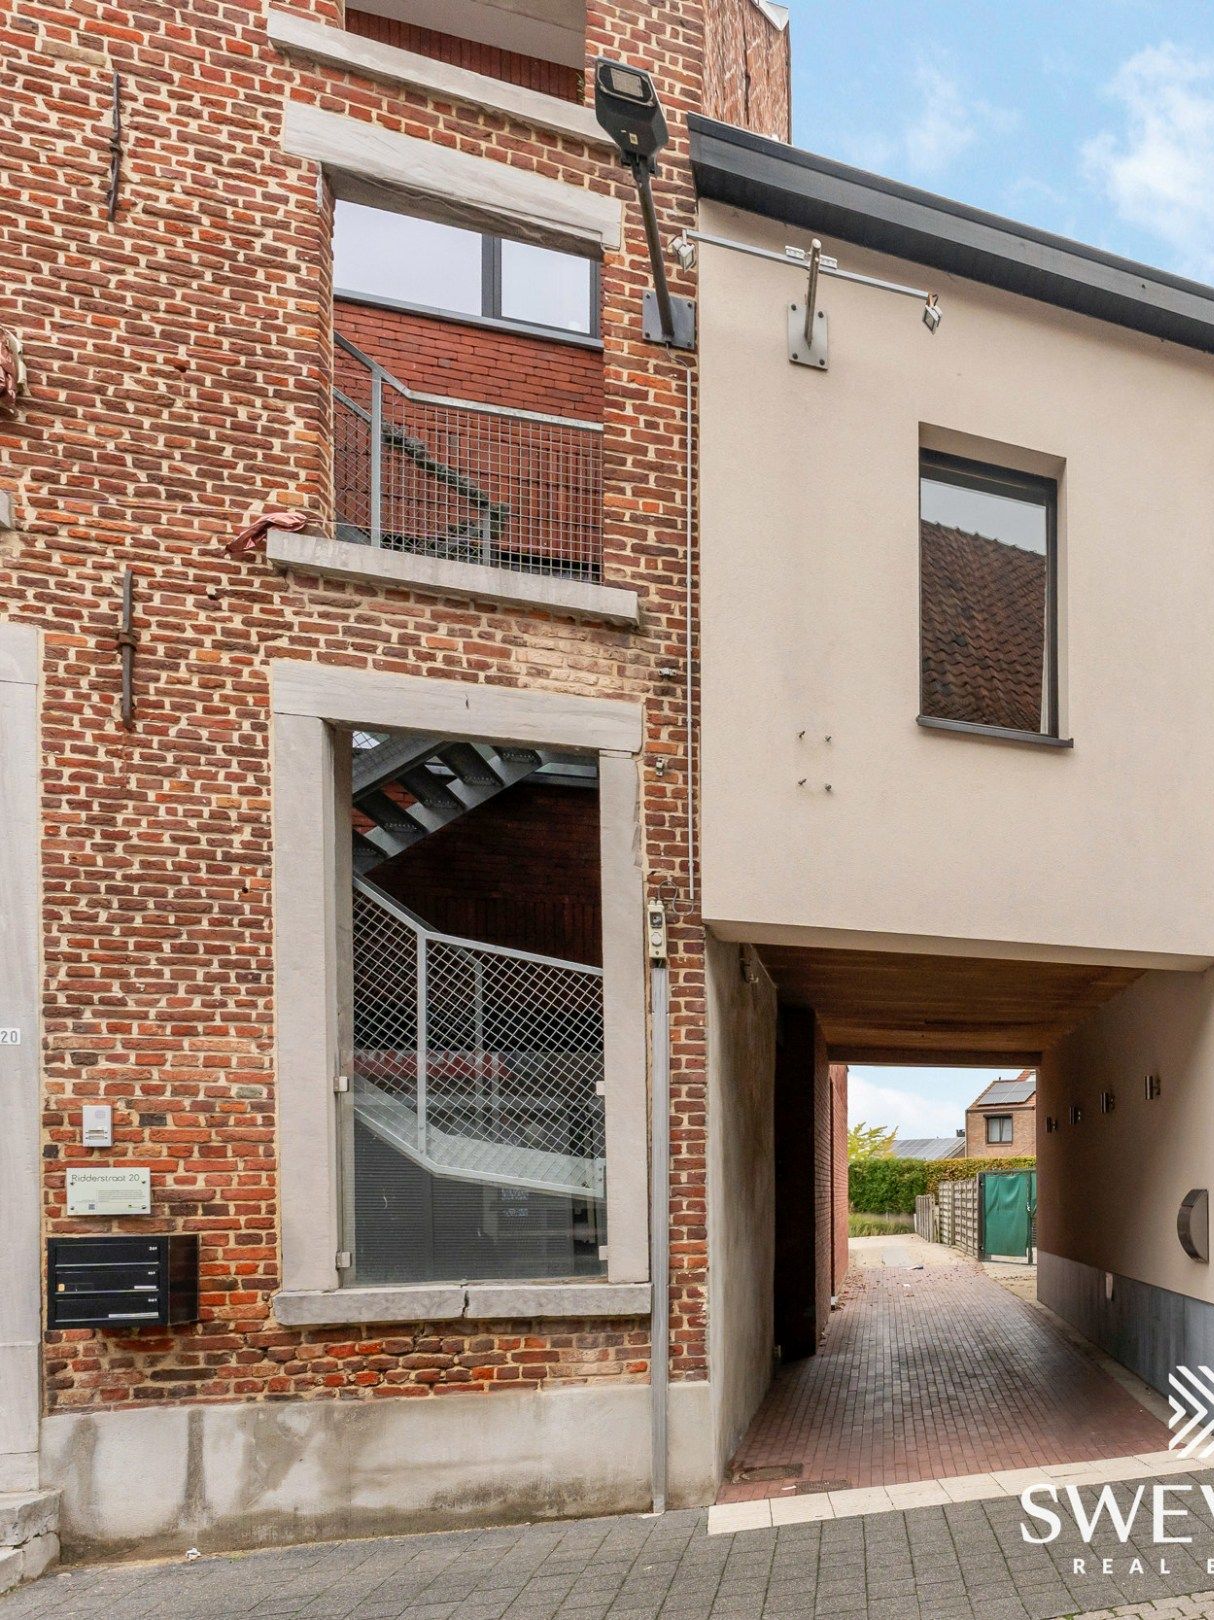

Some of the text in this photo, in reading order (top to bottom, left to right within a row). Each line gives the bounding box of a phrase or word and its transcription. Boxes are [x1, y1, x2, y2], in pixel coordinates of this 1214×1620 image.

[1, 1030, 18, 1043] 20
[71, 1173, 140, 1183] Ridderstraat 20
